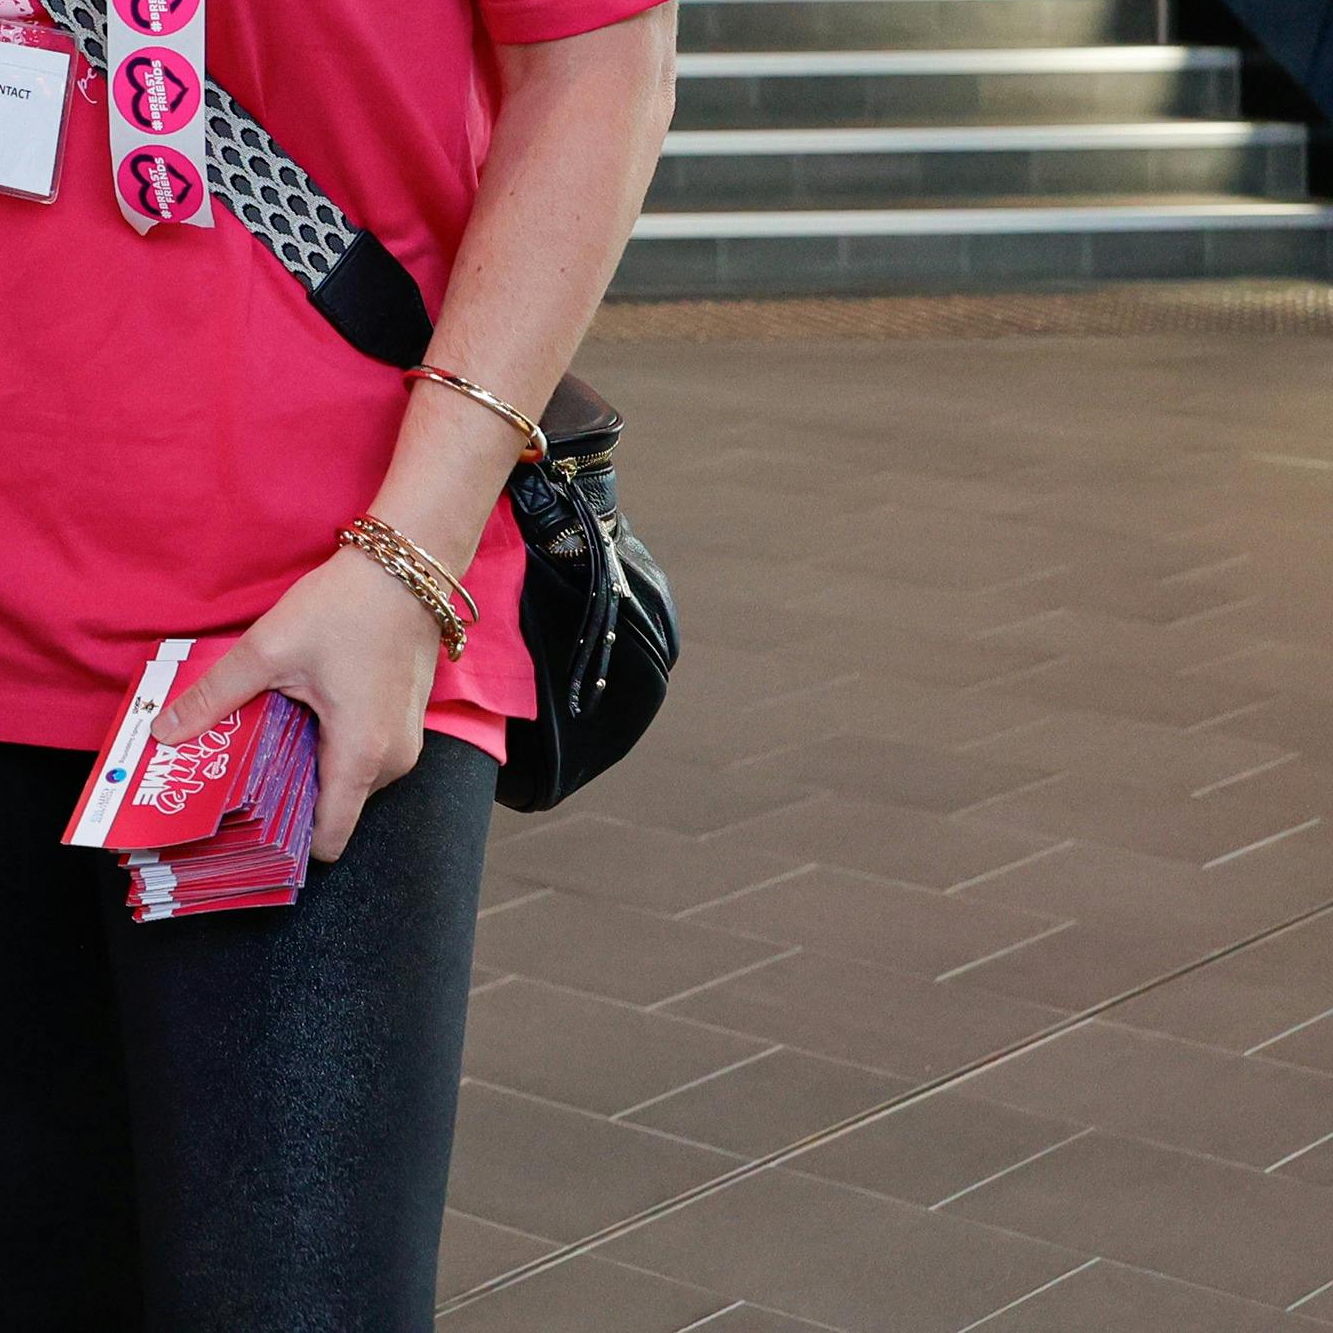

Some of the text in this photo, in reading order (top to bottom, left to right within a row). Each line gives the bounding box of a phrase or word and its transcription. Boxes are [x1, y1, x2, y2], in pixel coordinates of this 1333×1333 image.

[144, 71, 165, 132] #BREAST
[151, 59, 170, 113] FRIENDS
[148, 167, 173, 220] #BREAST
[154, 156, 176, 204] FRIENDS
[132, 741, 179, 806] AME
